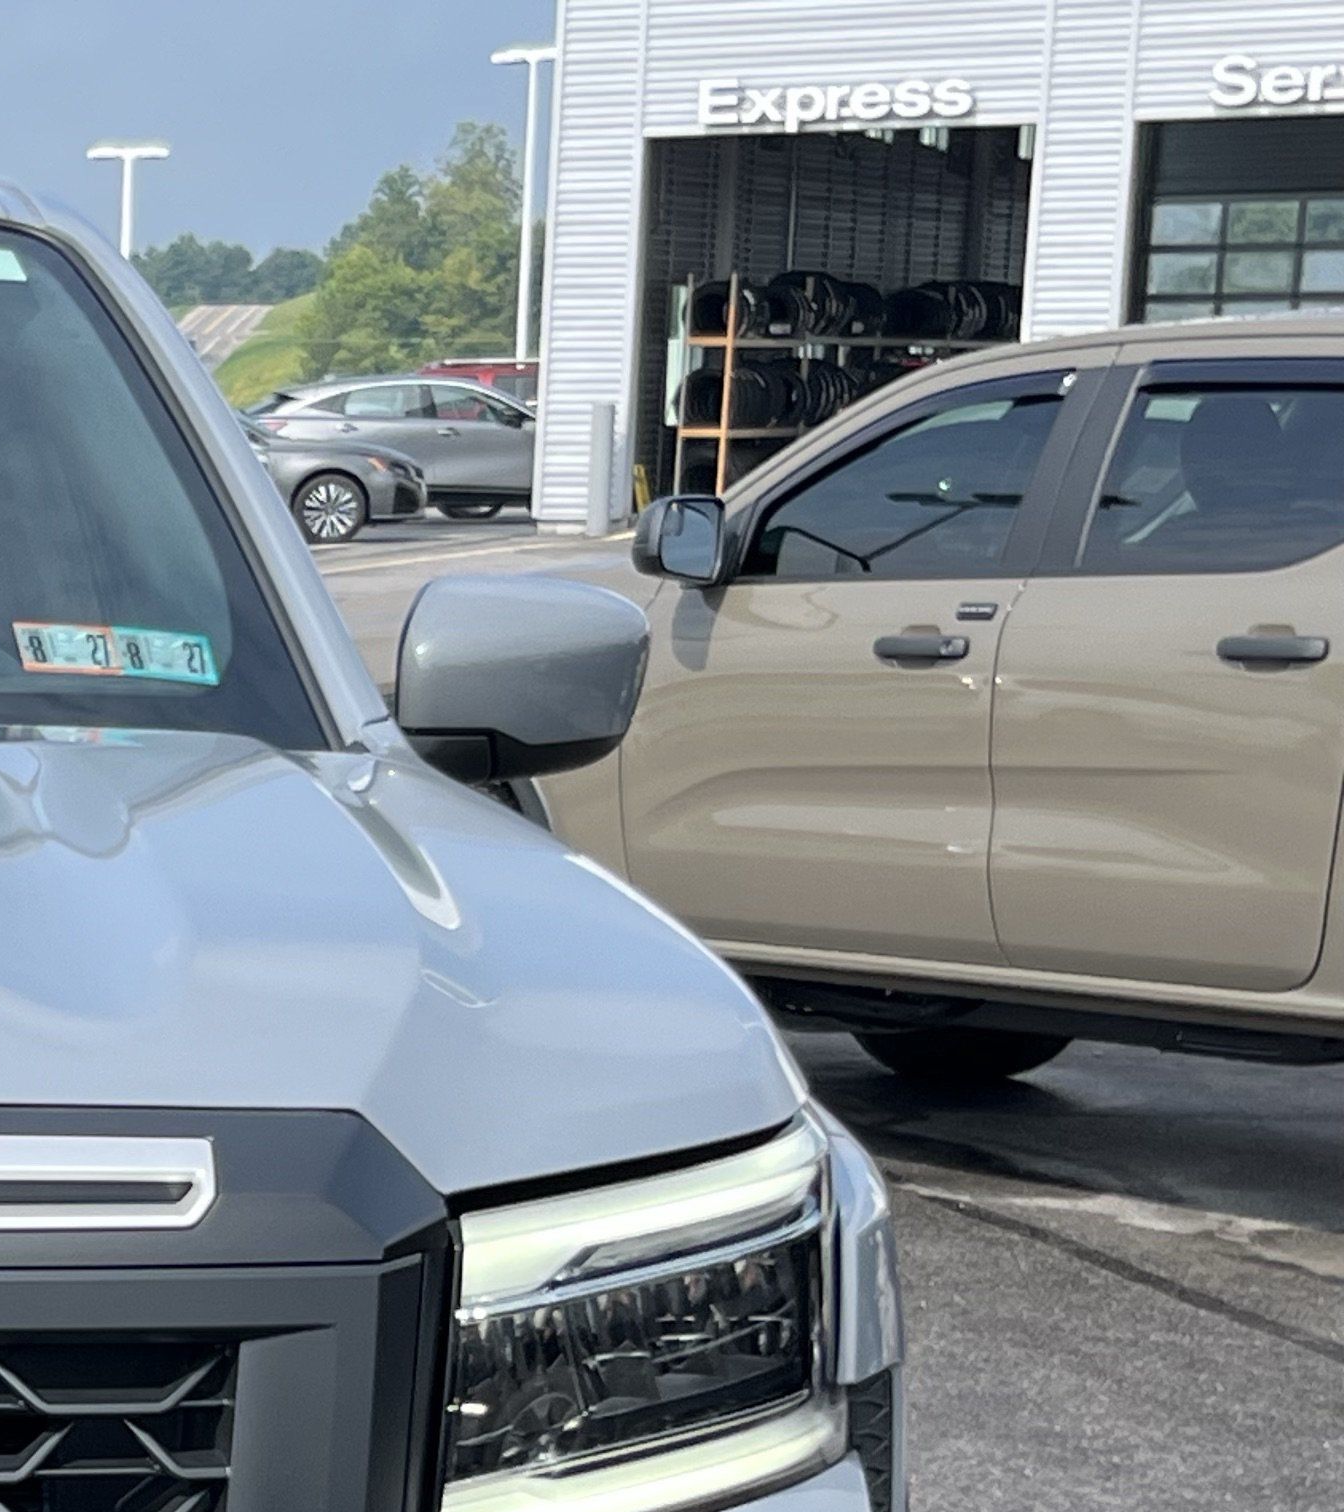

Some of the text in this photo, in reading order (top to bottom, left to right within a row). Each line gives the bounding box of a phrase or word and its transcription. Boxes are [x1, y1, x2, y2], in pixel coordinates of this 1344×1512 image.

[1210, 54, 1344, 107] Ser
[698, 77, 973, 133] Express
[86, 634, 111, 668] 27
[182, 642, 206, 674] 27
